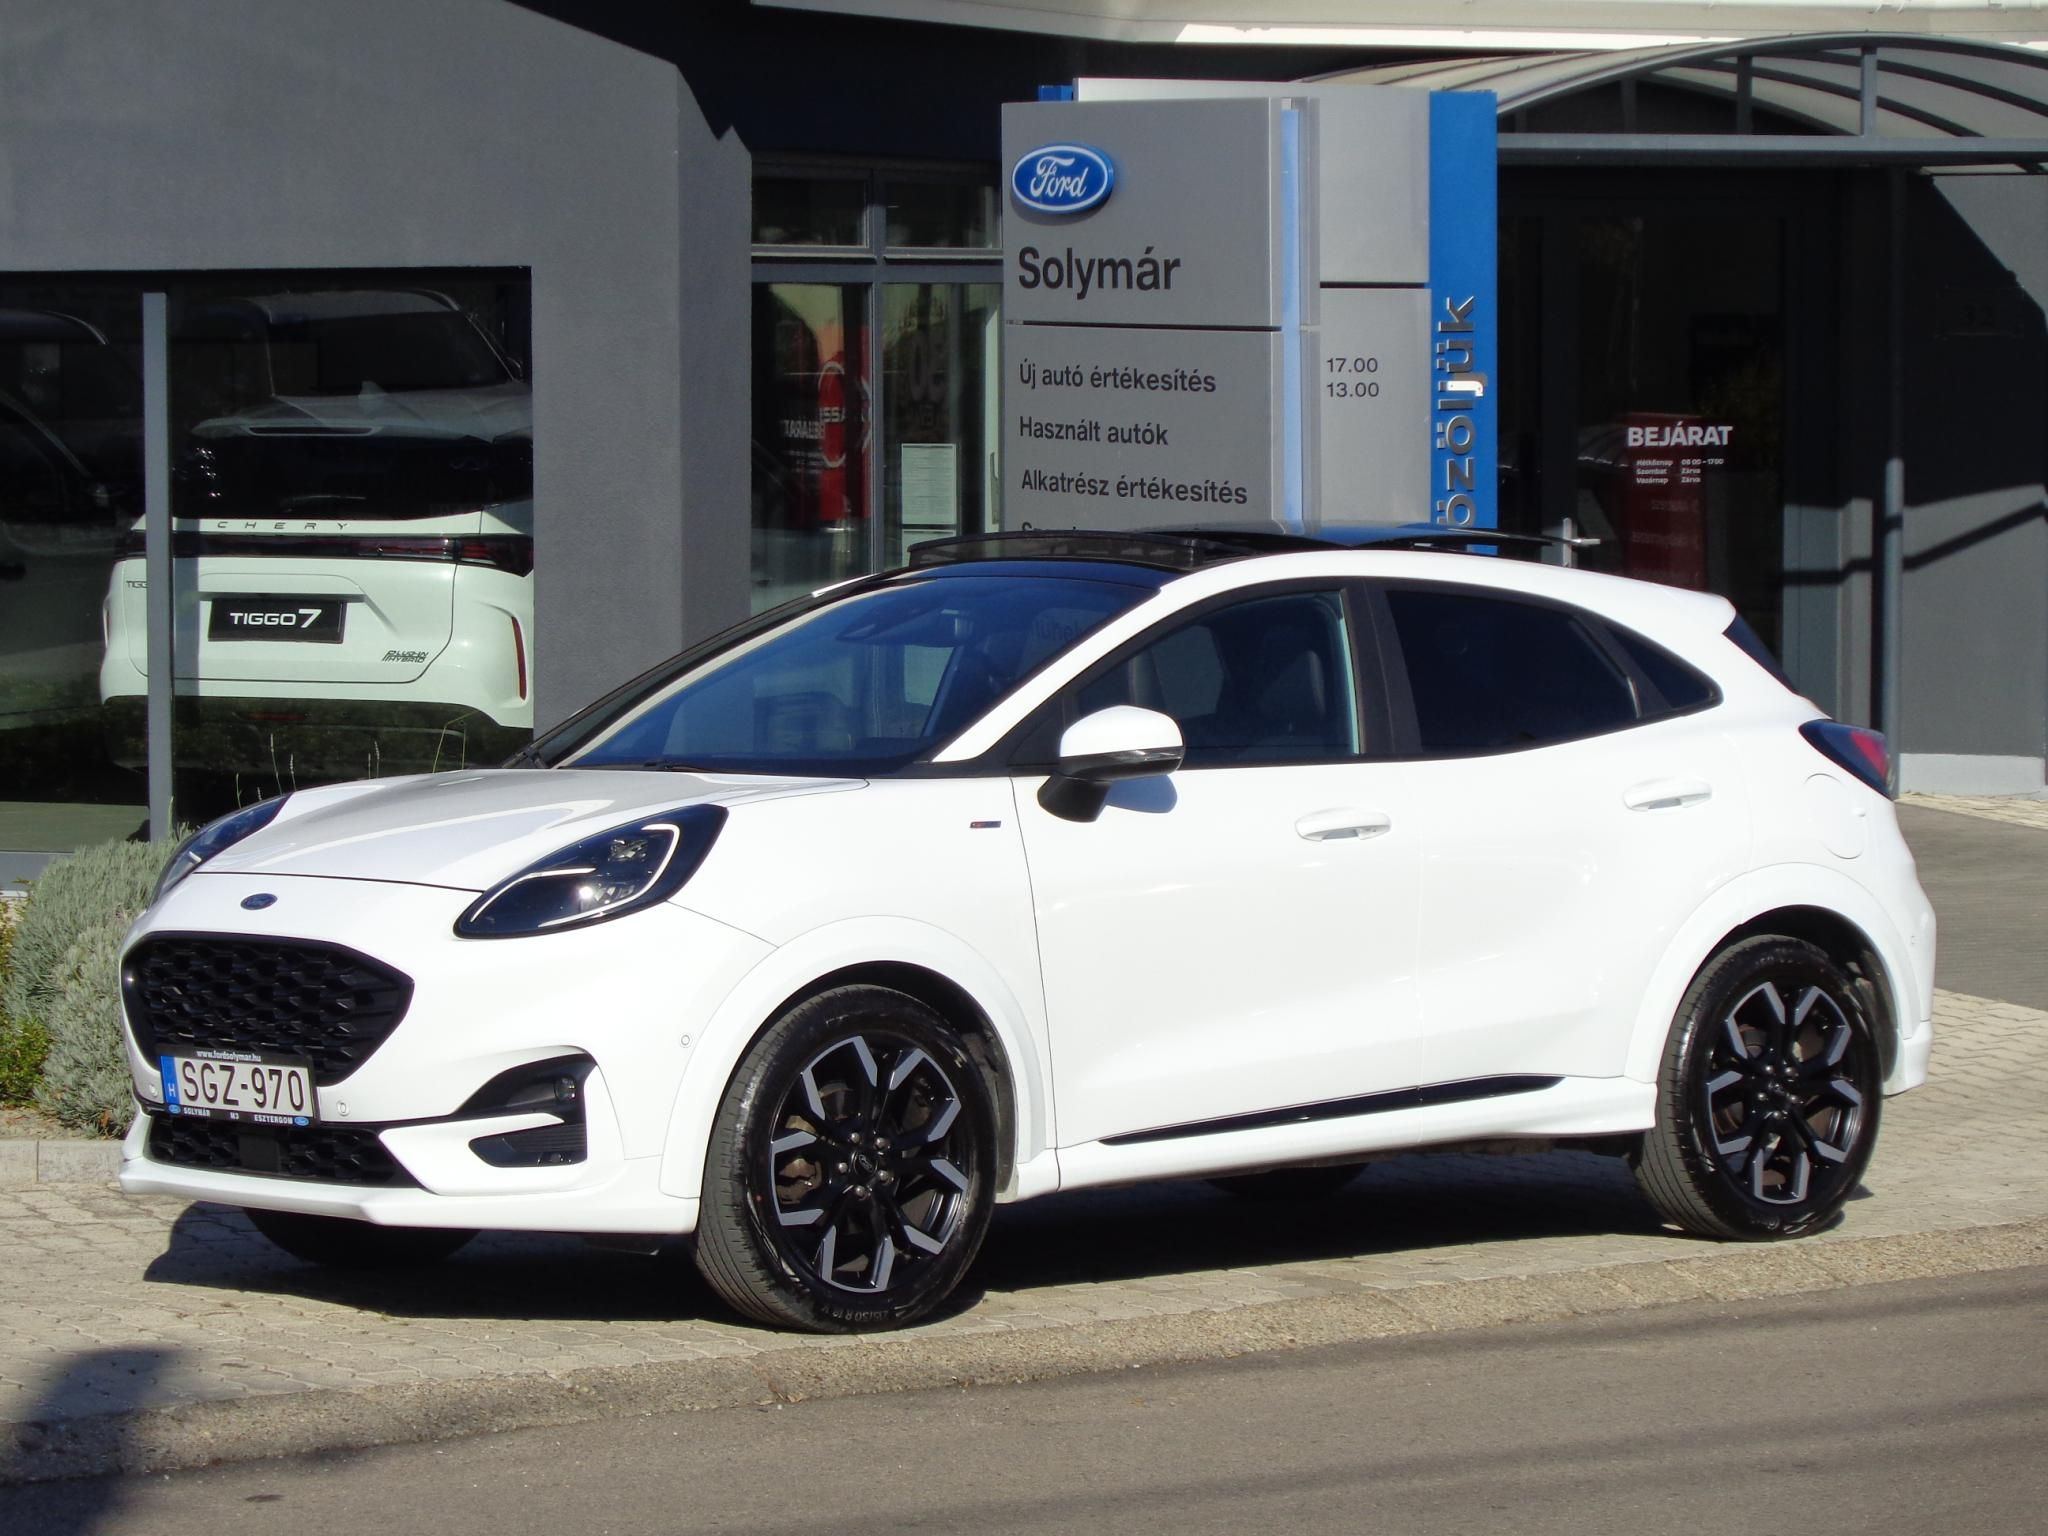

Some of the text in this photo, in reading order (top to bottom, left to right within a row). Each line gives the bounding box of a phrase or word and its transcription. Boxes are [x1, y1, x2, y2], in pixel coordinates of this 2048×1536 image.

[1030, 156, 1089, 197] Ford
[1018, 246, 1181, 300] Solymár
[1019, 358, 1216, 392] Új autó értékesítés
[1327, 357, 1378, 373] 17.00
[1327, 382, 1379, 398] 13.00
[1437, 296, 1488, 526] özöljük
[1019, 416, 1168, 445] Használt autók
[1627, 420, 1733, 447] BEJÁRAT
[1022, 469, 1248, 504] Alkatrész értékesítés
[217, 521, 348, 530] CHERY
[230, 608, 322, 629] TIGGO 7
[168, 1083, 176, 1097] H
[182, 1060, 305, 1112] SGZ-970
